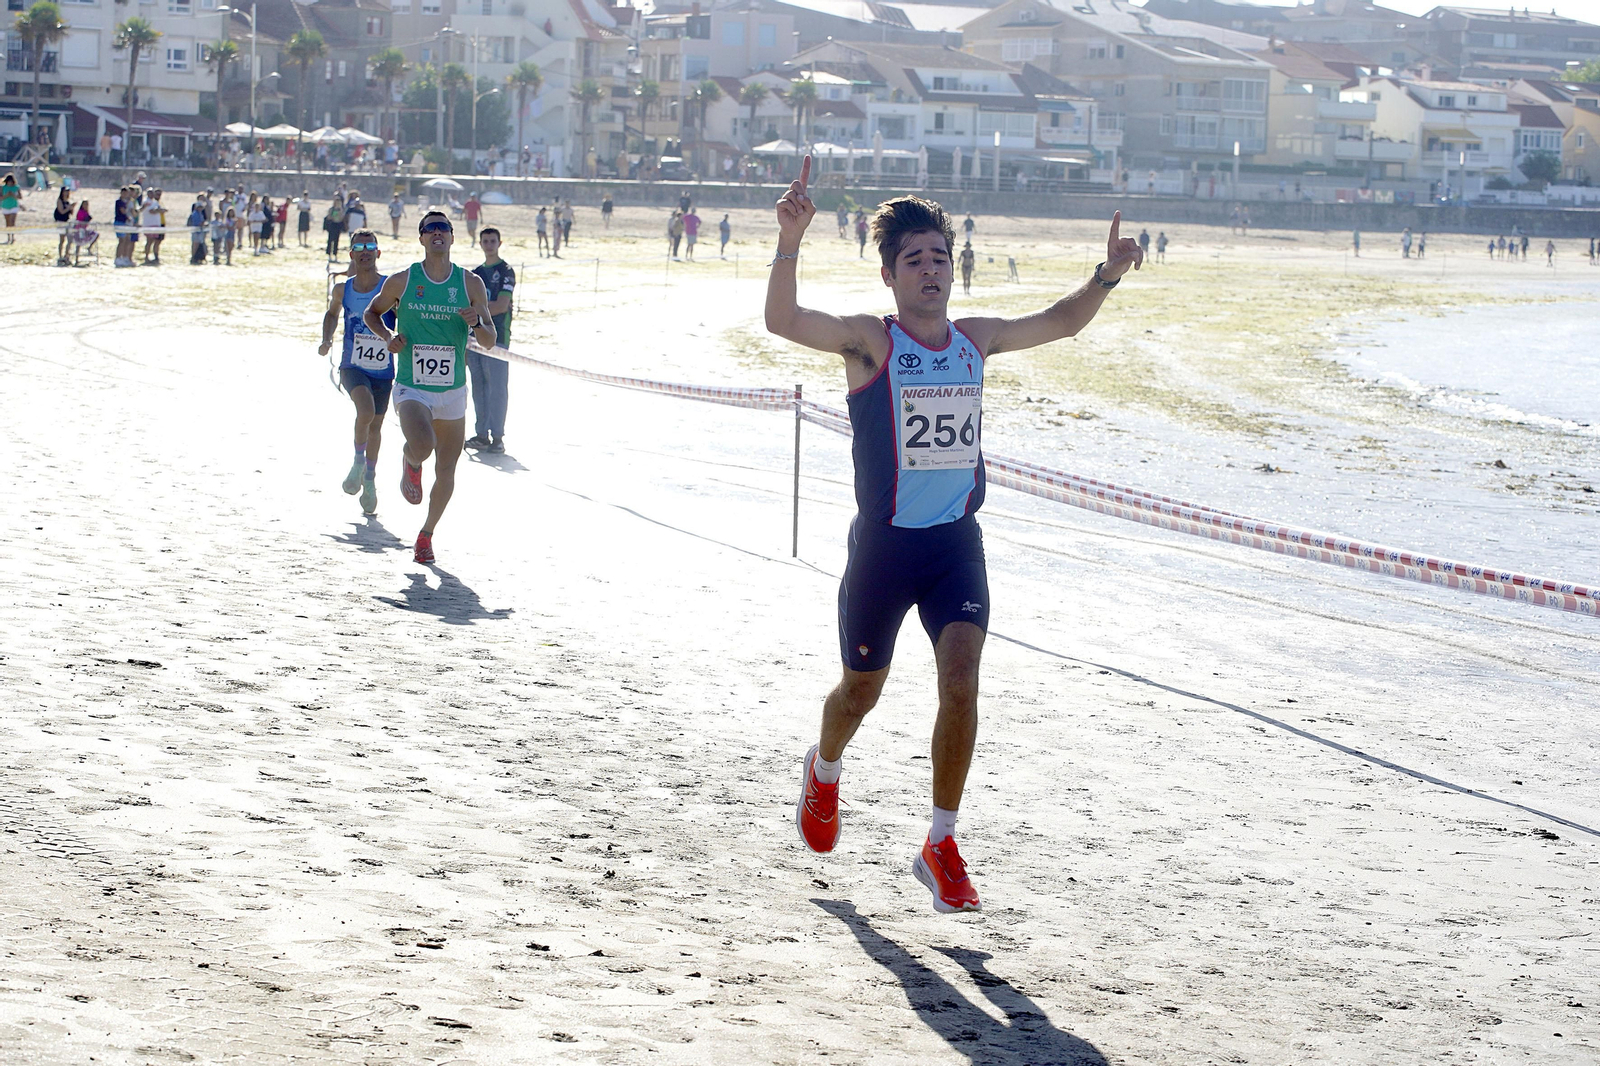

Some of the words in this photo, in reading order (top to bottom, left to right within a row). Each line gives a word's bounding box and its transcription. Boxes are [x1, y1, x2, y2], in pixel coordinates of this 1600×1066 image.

[408, 302, 426, 311] SAN
[428, 304, 462, 314] MIGUE
[420, 312, 451, 320] MARÍN
[355, 345, 386, 362] 146
[416, 358, 450, 375] 195
[902, 386, 954, 399] NIGRÁN
[953, 387, 980, 398] AREA
[906, 413, 975, 448] 256
